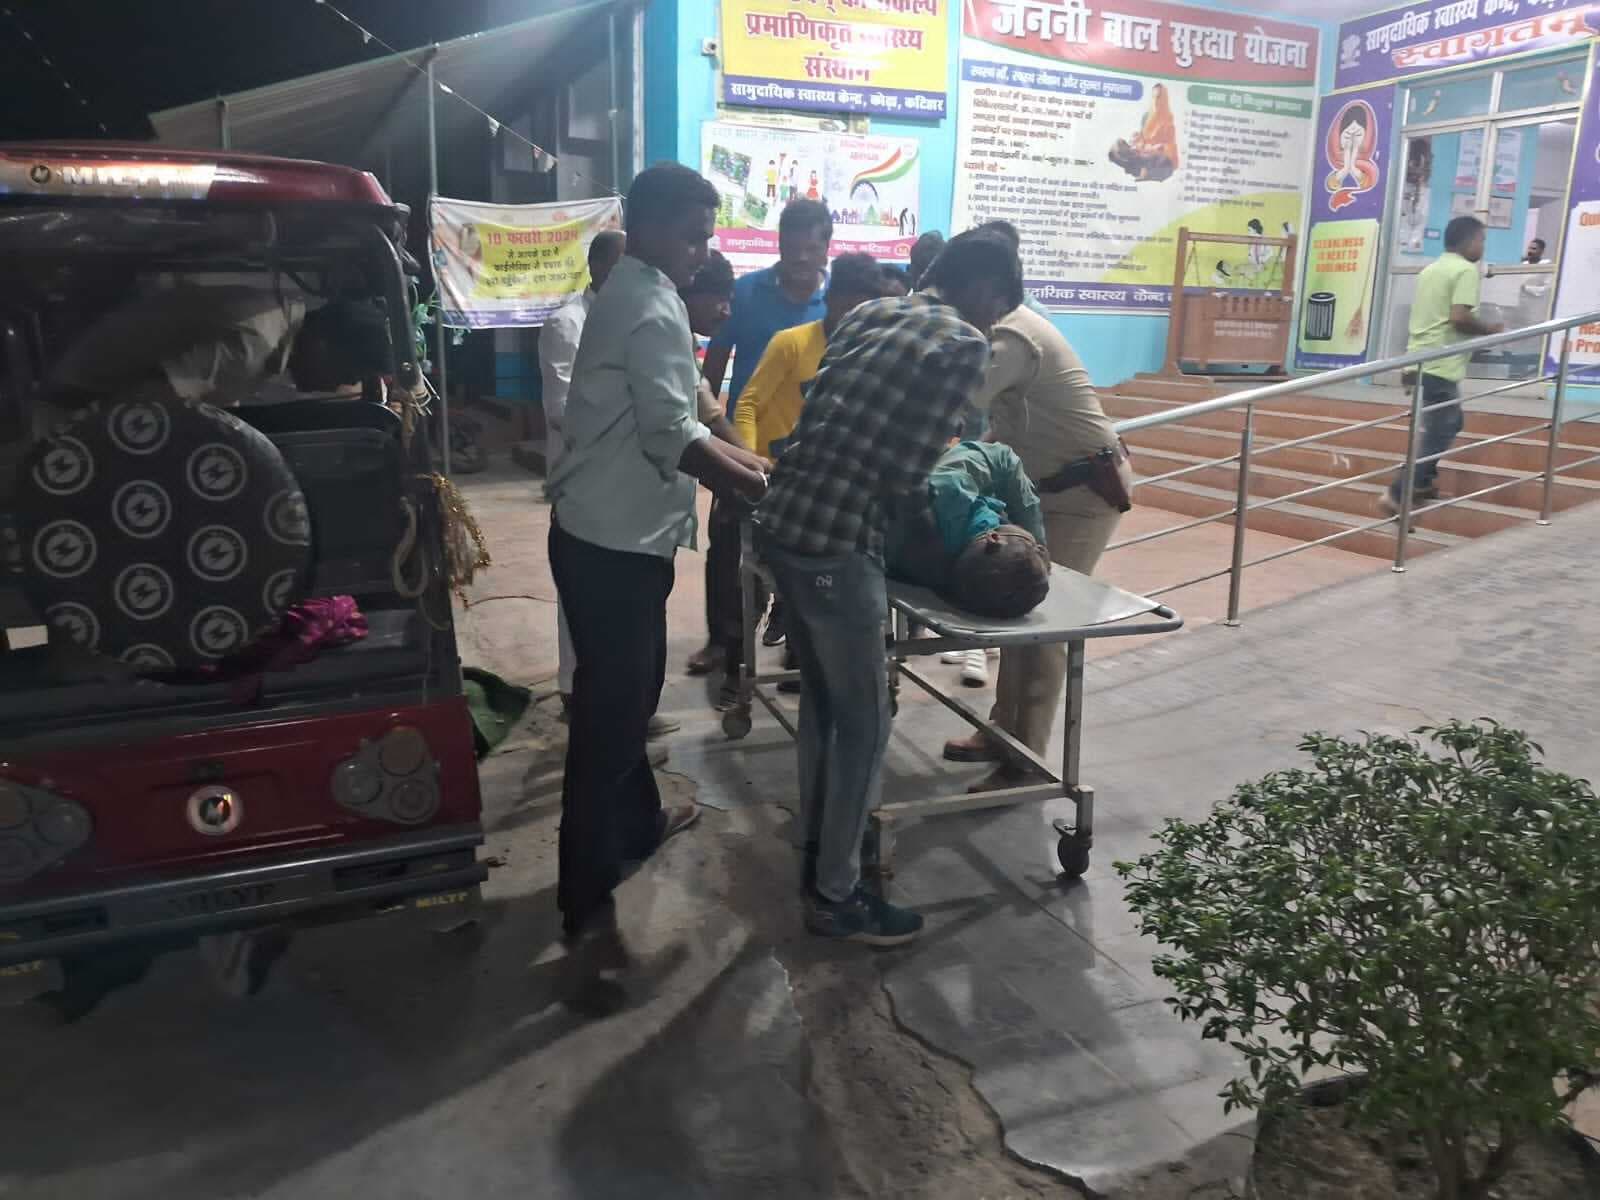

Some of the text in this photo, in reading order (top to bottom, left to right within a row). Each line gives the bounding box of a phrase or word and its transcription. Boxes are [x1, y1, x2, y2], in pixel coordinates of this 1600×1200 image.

[991, 0, 1310, 69] जननी बाल सुरक्षा योजना
[1366, 11, 1432, 54] सामुदायिक
[1434, 0, 1479, 30] स्वास्थ्य
[731, 82, 795, 101] सामुदायिक
[798, 89, 836, 103] स्वास्थ्य
[1078, 288, 1127, 301] स्वास्थ्य
